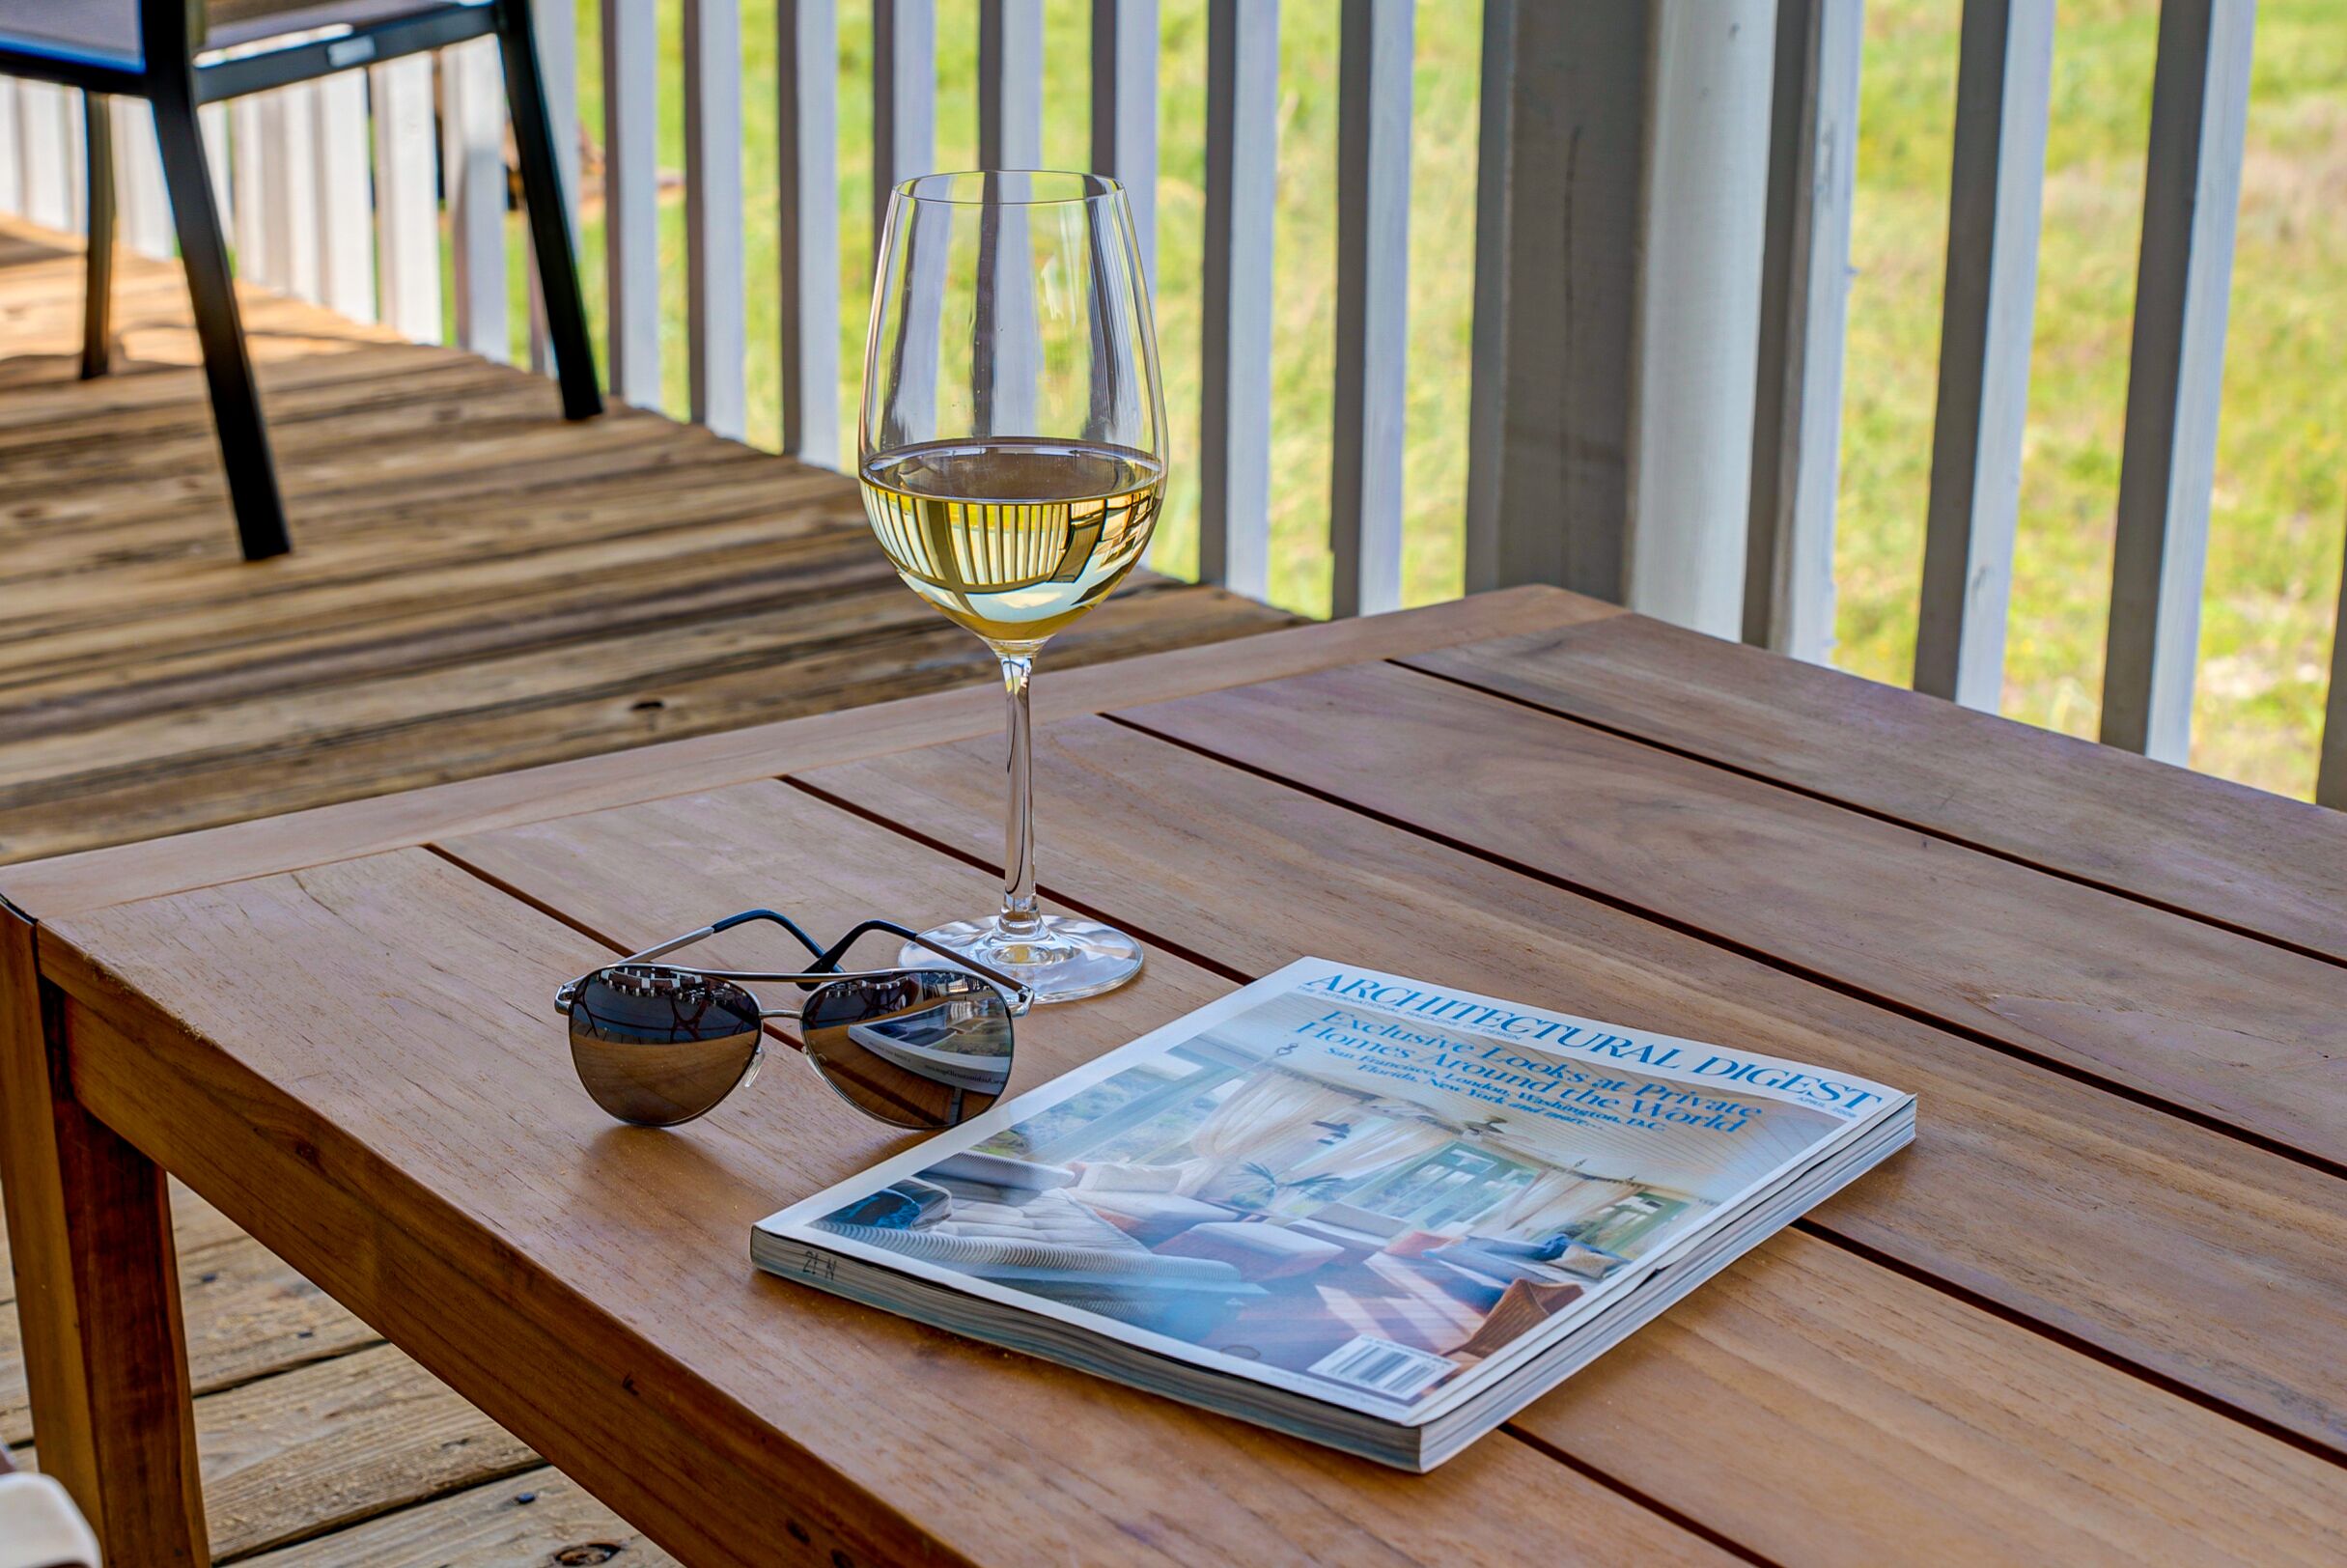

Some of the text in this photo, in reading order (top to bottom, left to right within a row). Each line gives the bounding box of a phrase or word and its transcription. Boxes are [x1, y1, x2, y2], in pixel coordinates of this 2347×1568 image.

[1296, 1022, 1747, 1133] Homes Around the World
[1304, 973, 1883, 1109] ARCHITECTURAL DIGEST
[1320, 1011, 1763, 1117] Exclusive Looks at Private
[1324, 1047, 1355, 1060] San
[1358, 1054, 1438, 1078] Francisco,
[1443, 1073, 1511, 1098] London,
[1518, 1091, 1622, 1124] Washington,
[1357, 1063, 1418, 1082] Florida,
[1424, 1078, 1463, 1092] New
[1467, 1088, 1507, 1105] York
[1507, 1102, 1546, 1113] and
